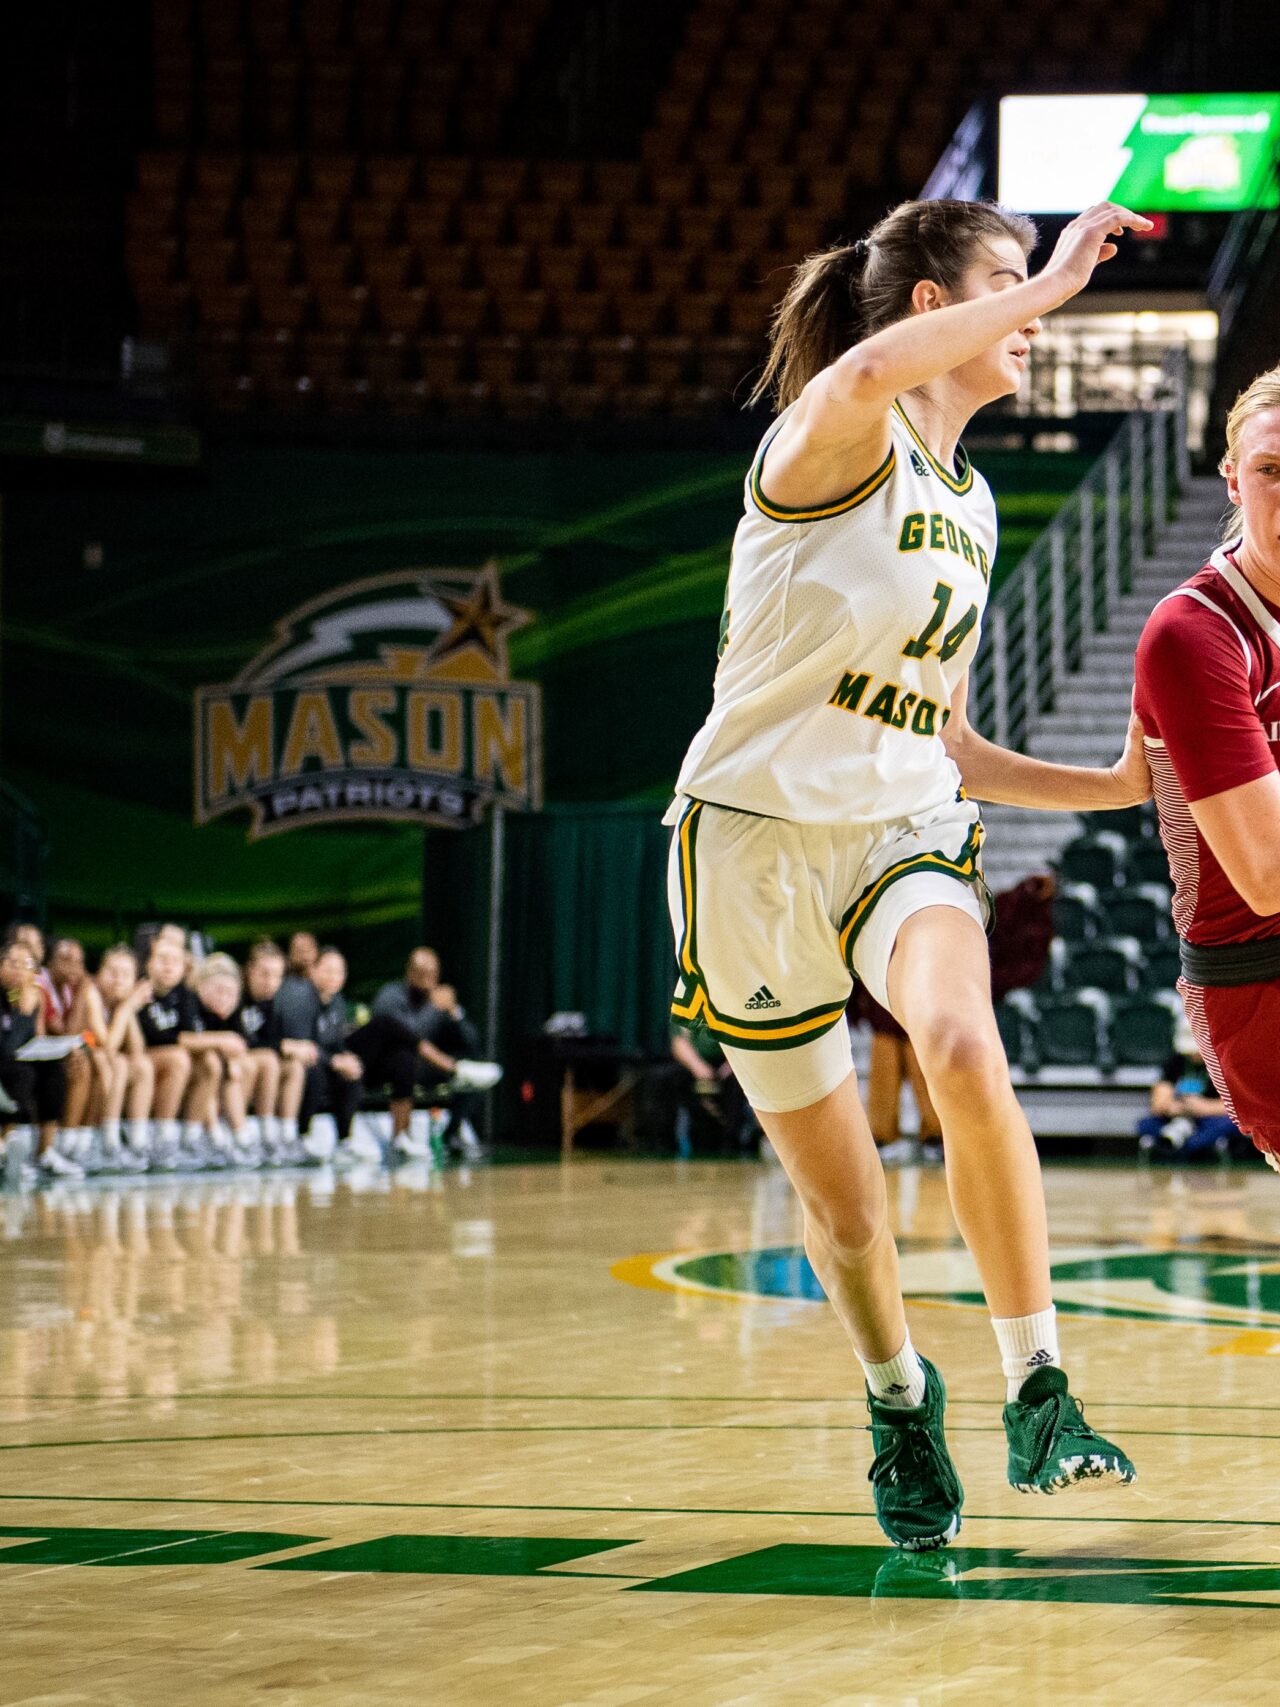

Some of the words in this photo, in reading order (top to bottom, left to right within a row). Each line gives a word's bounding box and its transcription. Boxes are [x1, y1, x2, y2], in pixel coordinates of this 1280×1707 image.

[900, 579, 978, 664] 14
[206, 687, 528, 801] MASON
[270, 779, 466, 818] PATRIOTS
[744, 999, 782, 1010] adidas
